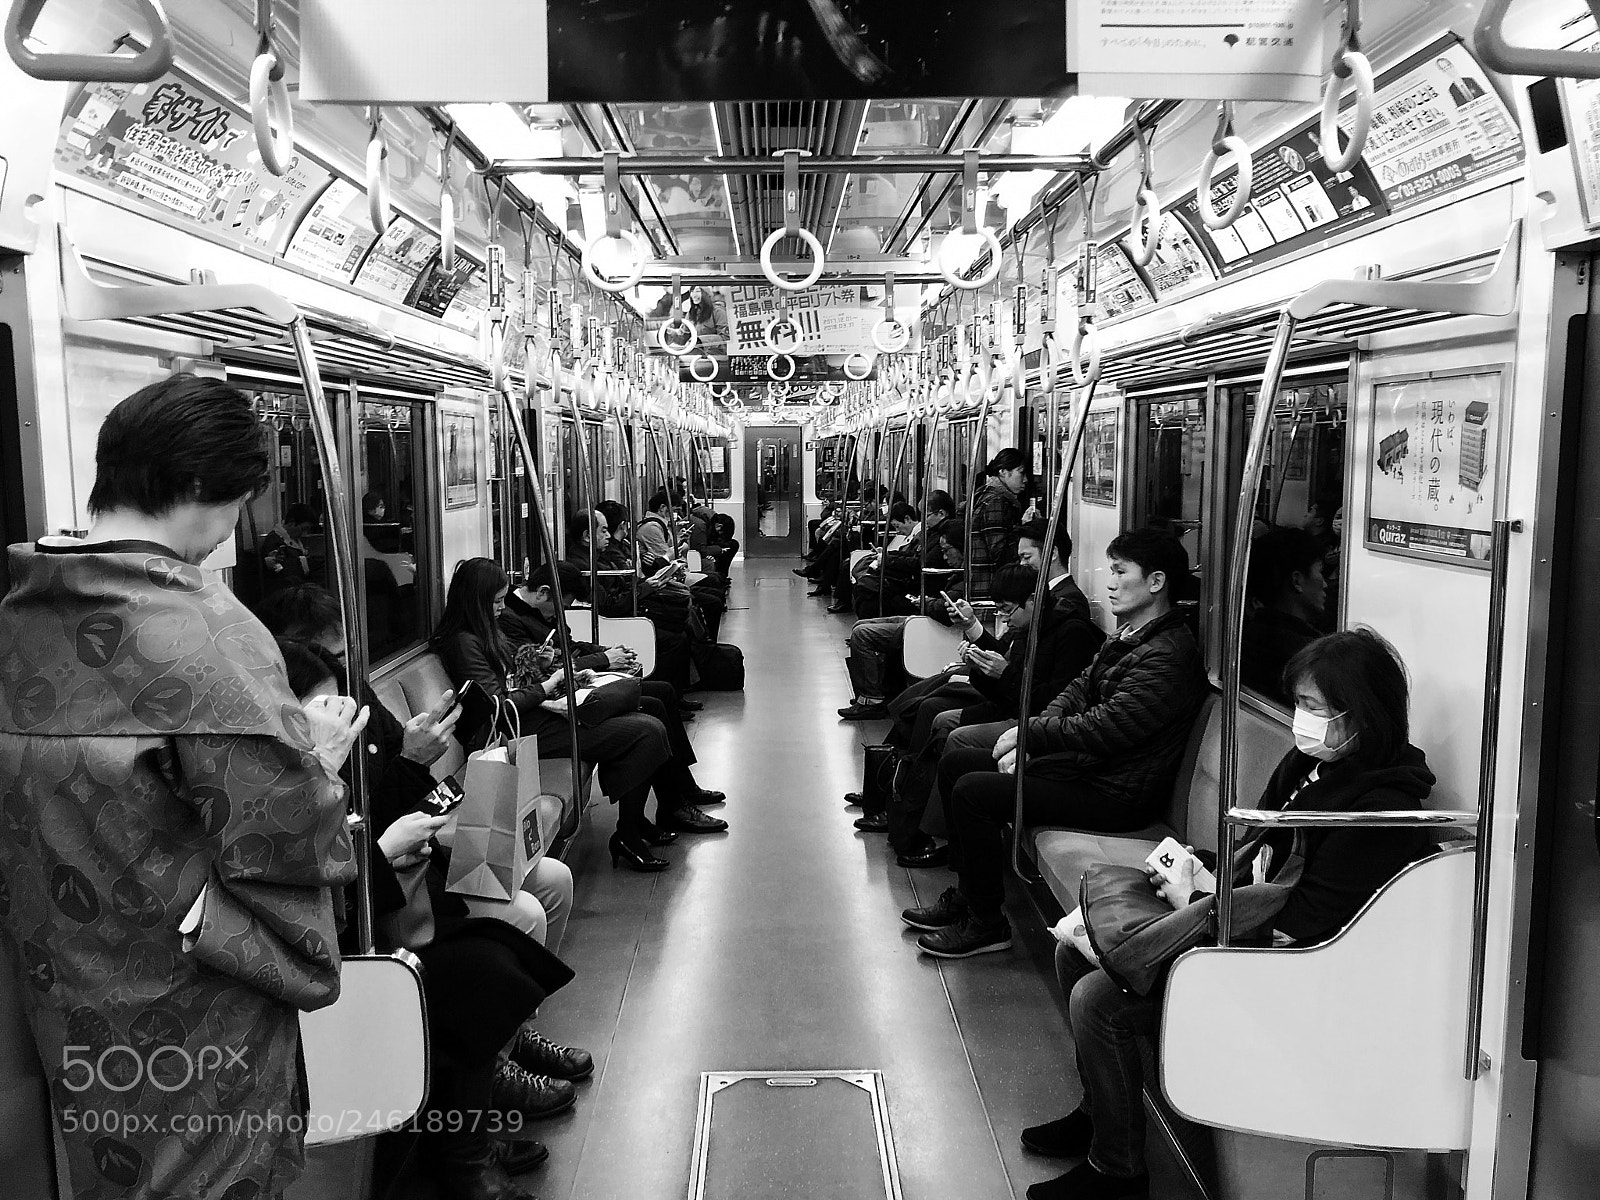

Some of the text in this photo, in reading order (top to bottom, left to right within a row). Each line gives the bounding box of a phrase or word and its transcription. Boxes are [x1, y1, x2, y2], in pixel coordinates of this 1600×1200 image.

[1427, 400, 1444, 512] 現代の蔵。
[1379, 528, 1407, 544] Quraz
